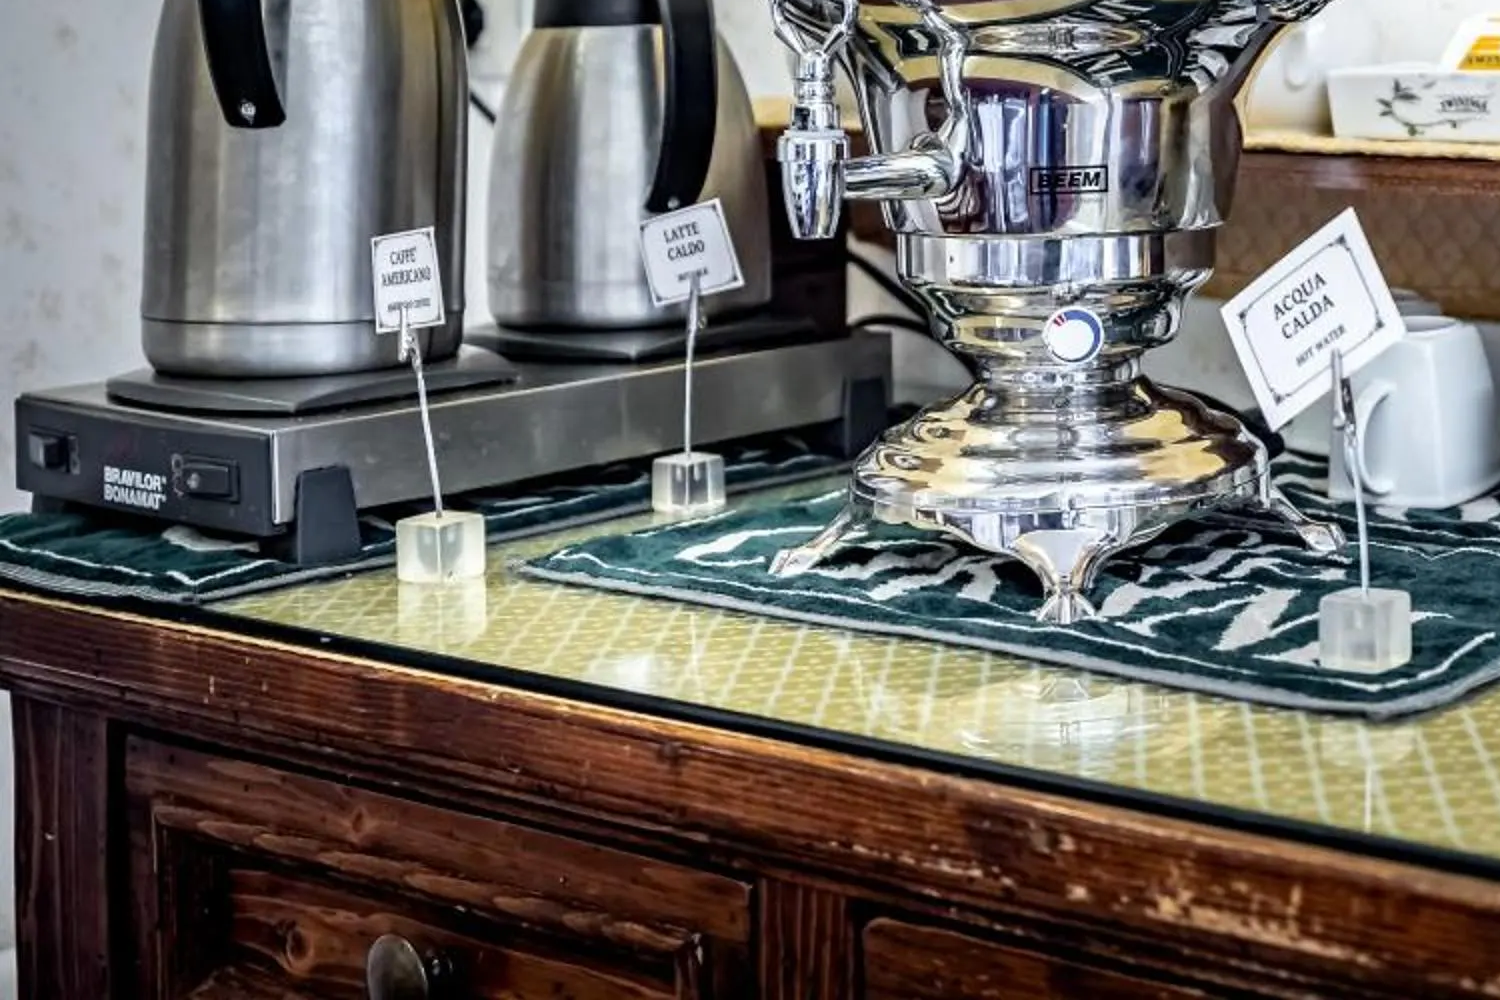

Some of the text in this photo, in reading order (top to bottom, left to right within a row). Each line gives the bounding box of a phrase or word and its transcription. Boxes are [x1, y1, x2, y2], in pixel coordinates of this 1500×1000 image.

[1038, 171, 1100, 188] BEEM
[663, 221, 700, 243] LATTE
[667, 239, 705, 261] CALDO
[381, 265, 432, 287] AMERICANO
[1273, 271, 1327, 321] ACQUA
[1281, 294, 1335, 339] CALDA
[1296, 323, 1347, 367] HOT WATER
